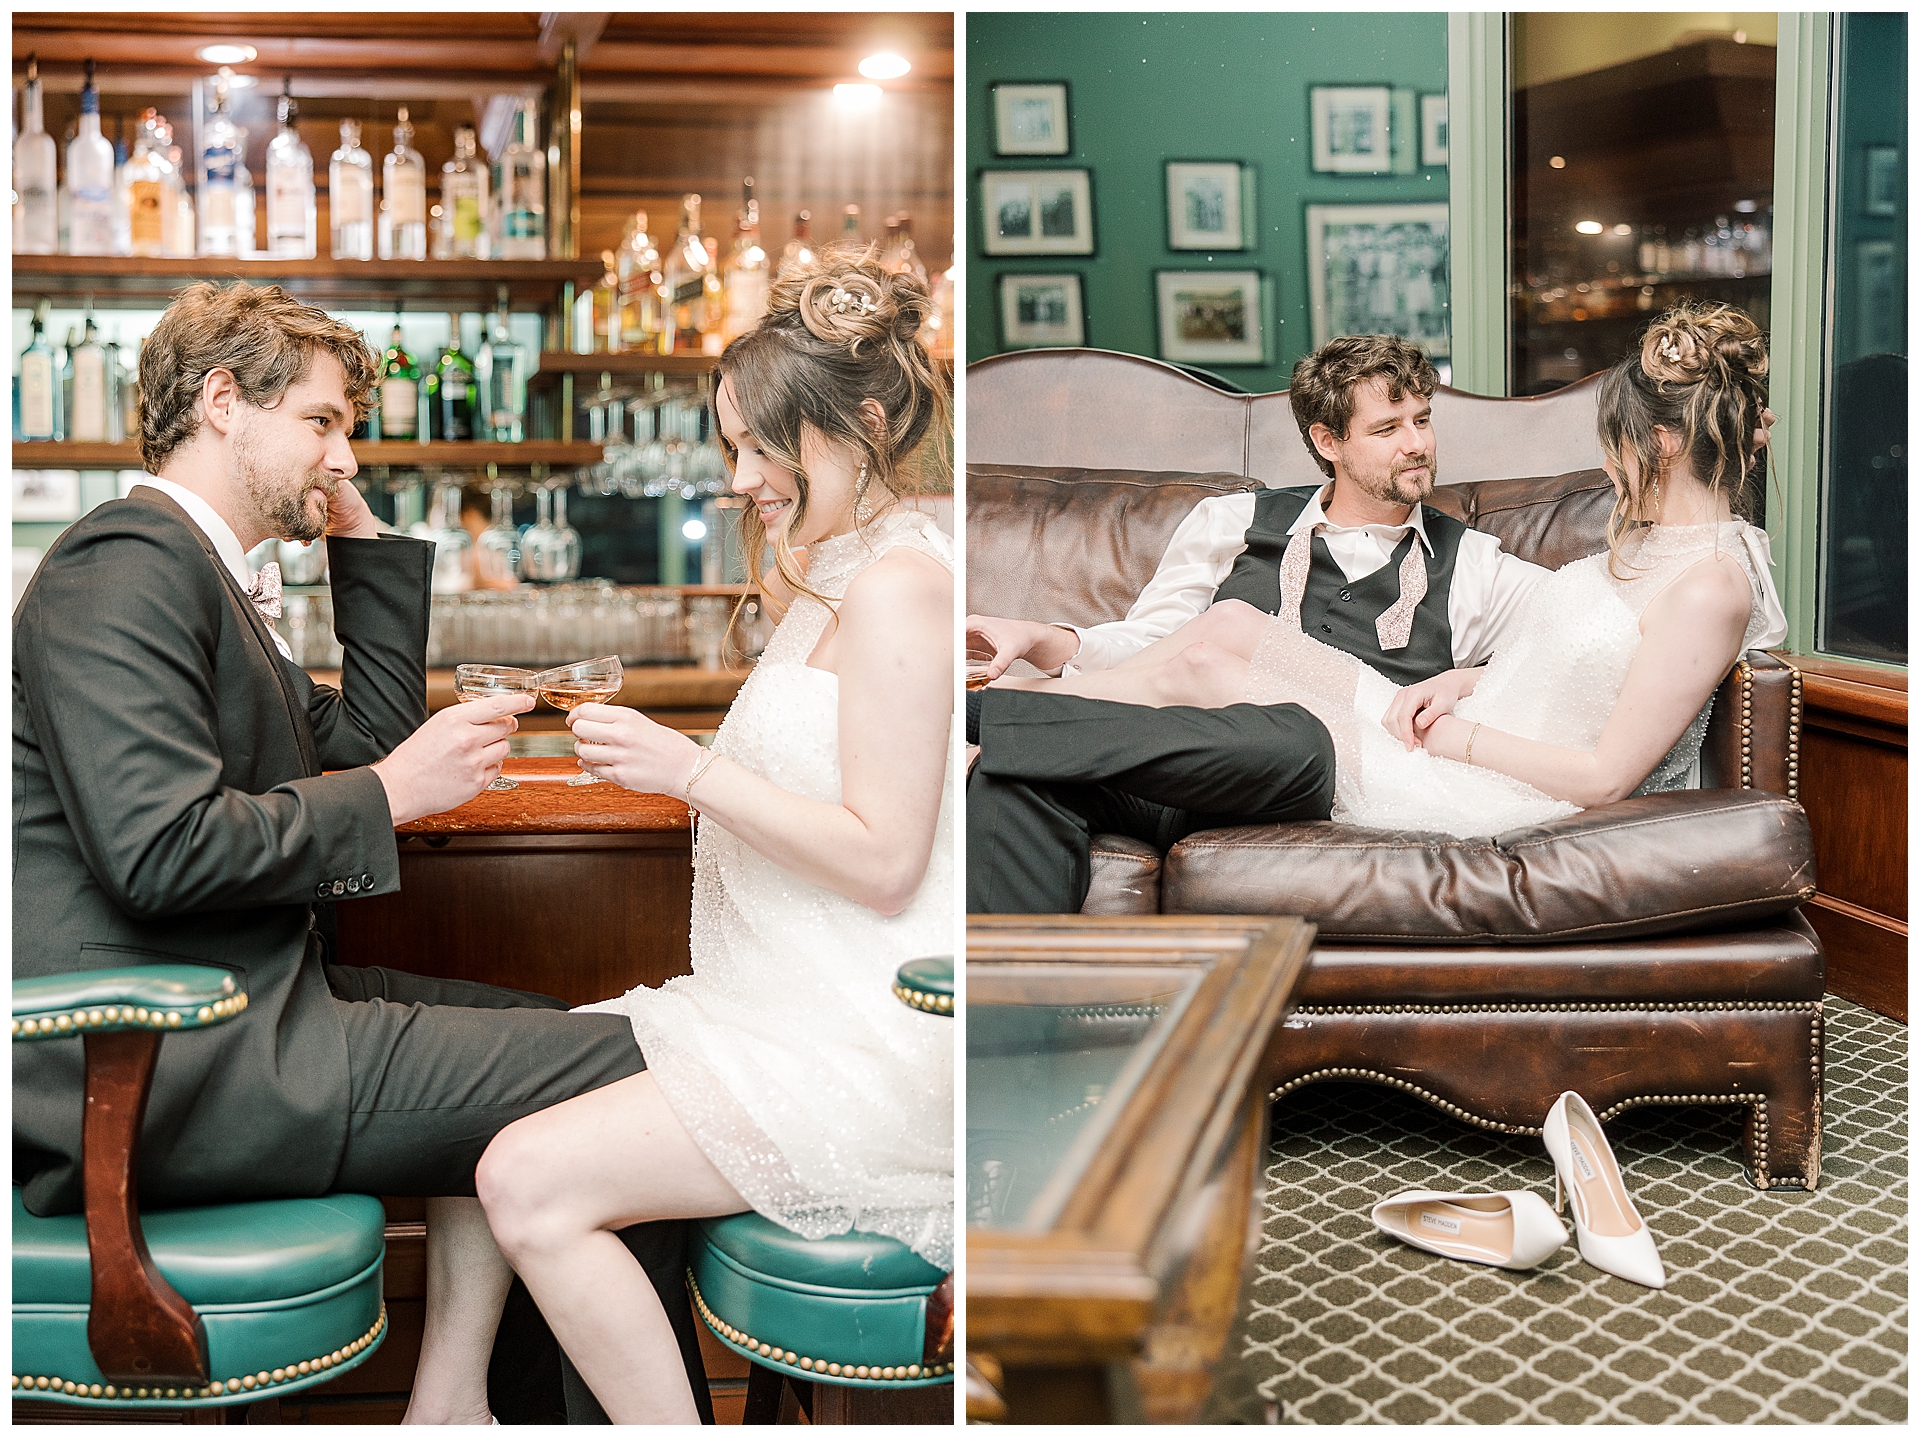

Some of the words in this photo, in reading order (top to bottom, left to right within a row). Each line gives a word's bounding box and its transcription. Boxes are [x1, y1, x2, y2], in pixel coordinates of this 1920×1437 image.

[1570, 1141, 1580, 1156] STEVE
[1578, 1156, 1592, 1176] MADDEN
[1423, 1215, 1437, 1225] STEVE
[1437, 1218, 1457, 1229] MADDEN
